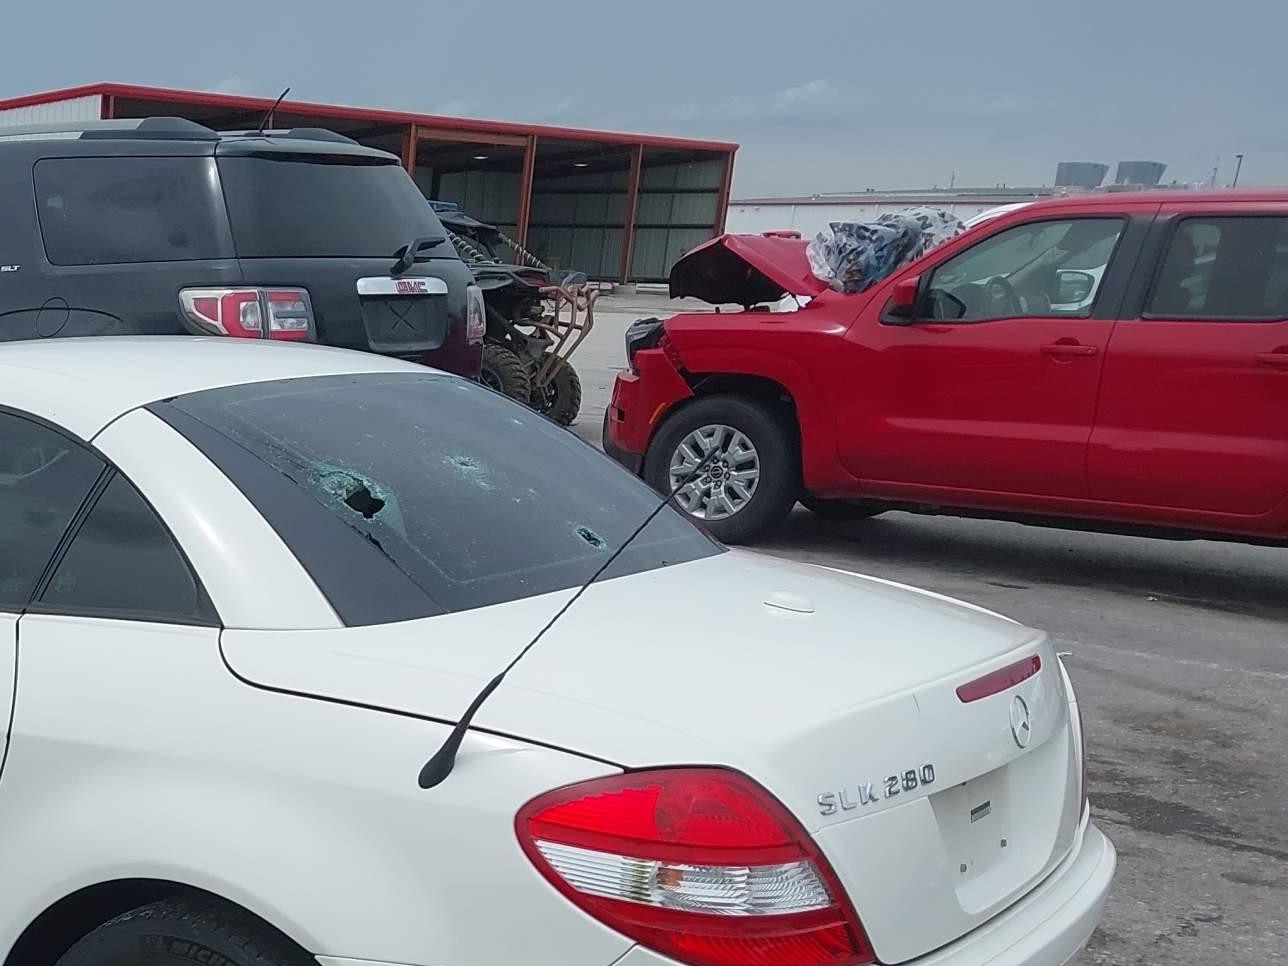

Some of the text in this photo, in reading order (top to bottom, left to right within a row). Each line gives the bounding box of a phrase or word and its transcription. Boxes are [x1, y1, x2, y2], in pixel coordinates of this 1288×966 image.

[394, 280, 428, 293] GMC
[817, 763, 936, 816] SLK 280
